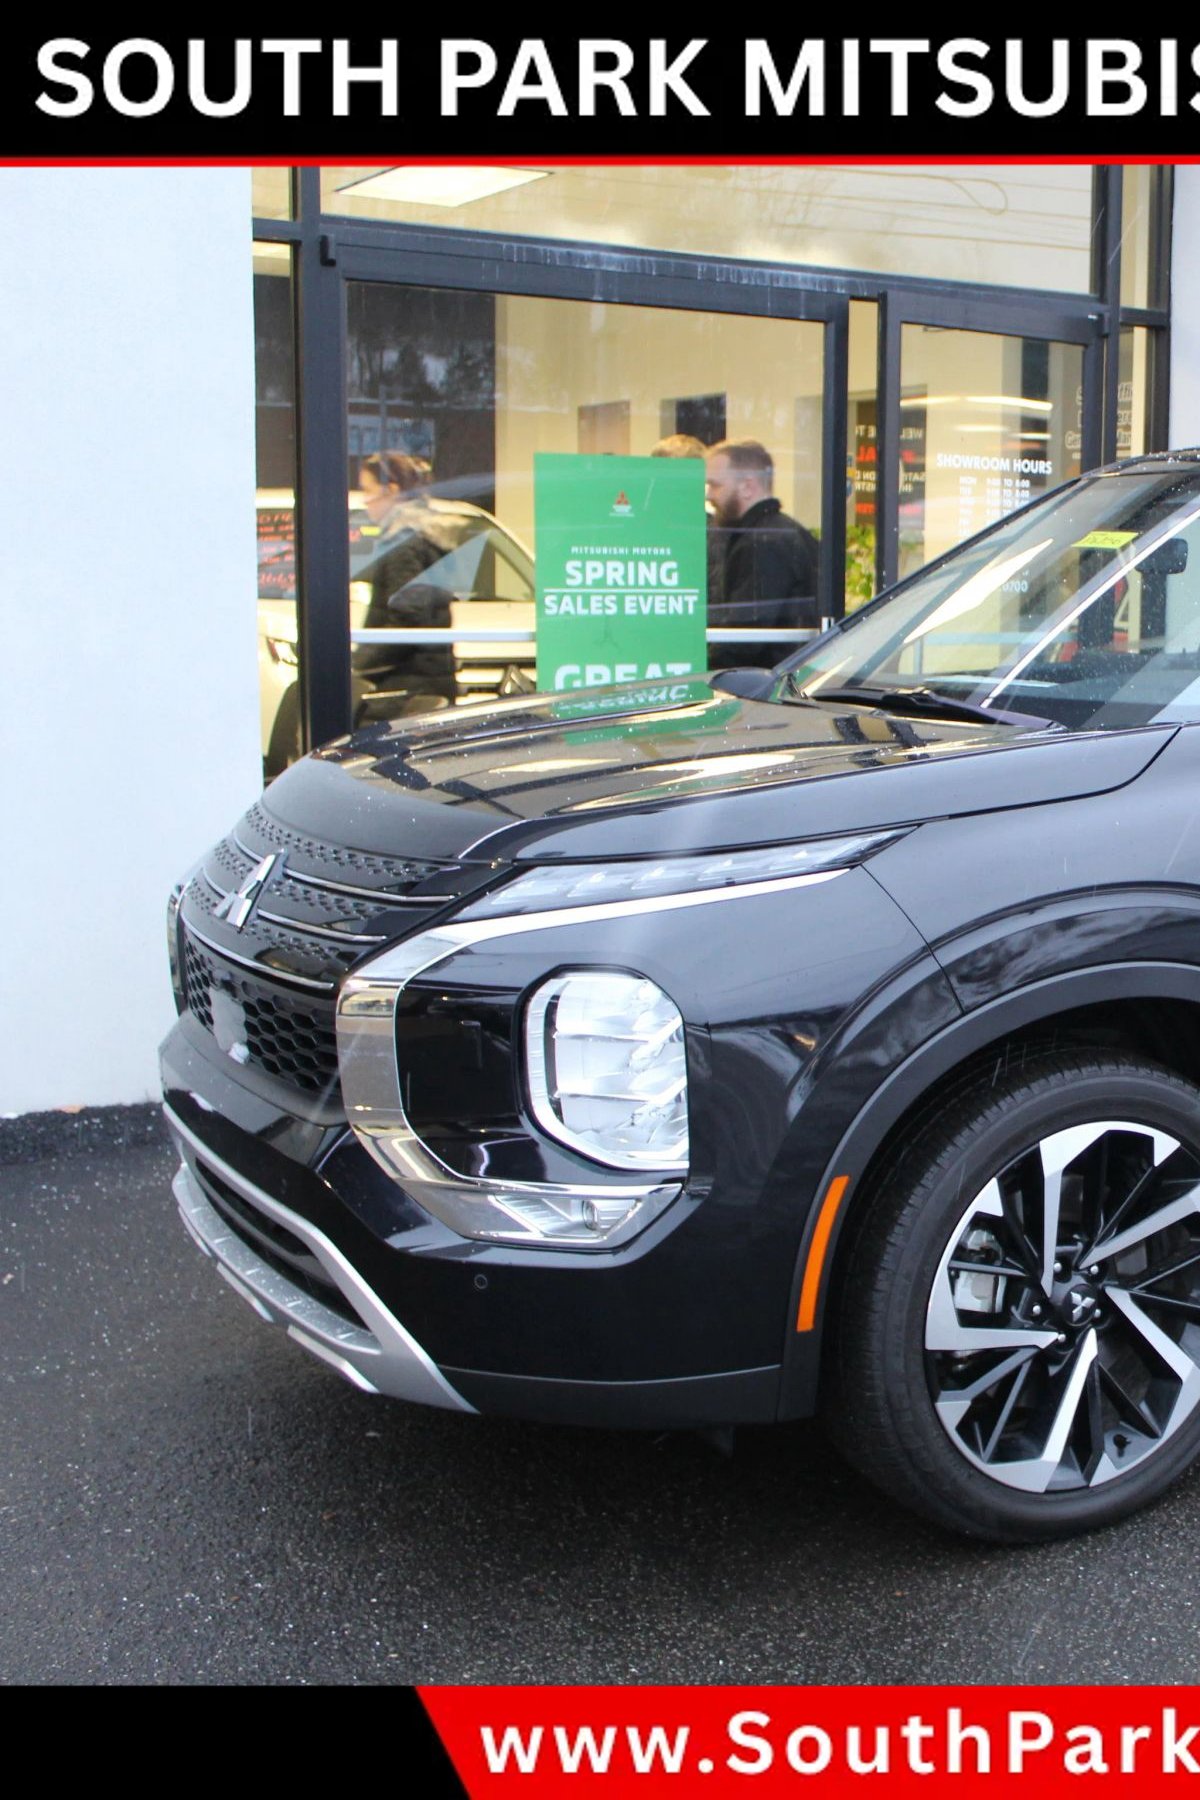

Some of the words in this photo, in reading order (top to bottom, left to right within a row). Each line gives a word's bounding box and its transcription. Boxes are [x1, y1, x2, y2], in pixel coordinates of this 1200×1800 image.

[937, 453, 1010, 471] SHOWROOM
[1013, 459, 1052, 475] HOURS
[571, 546, 628, 555] MITSUBISHI
[632, 547, 672, 556] MOTORS
[565, 560, 678, 586] SPRING
[544, 595, 617, 615] SALES
[625, 595, 698, 615] EVENT
